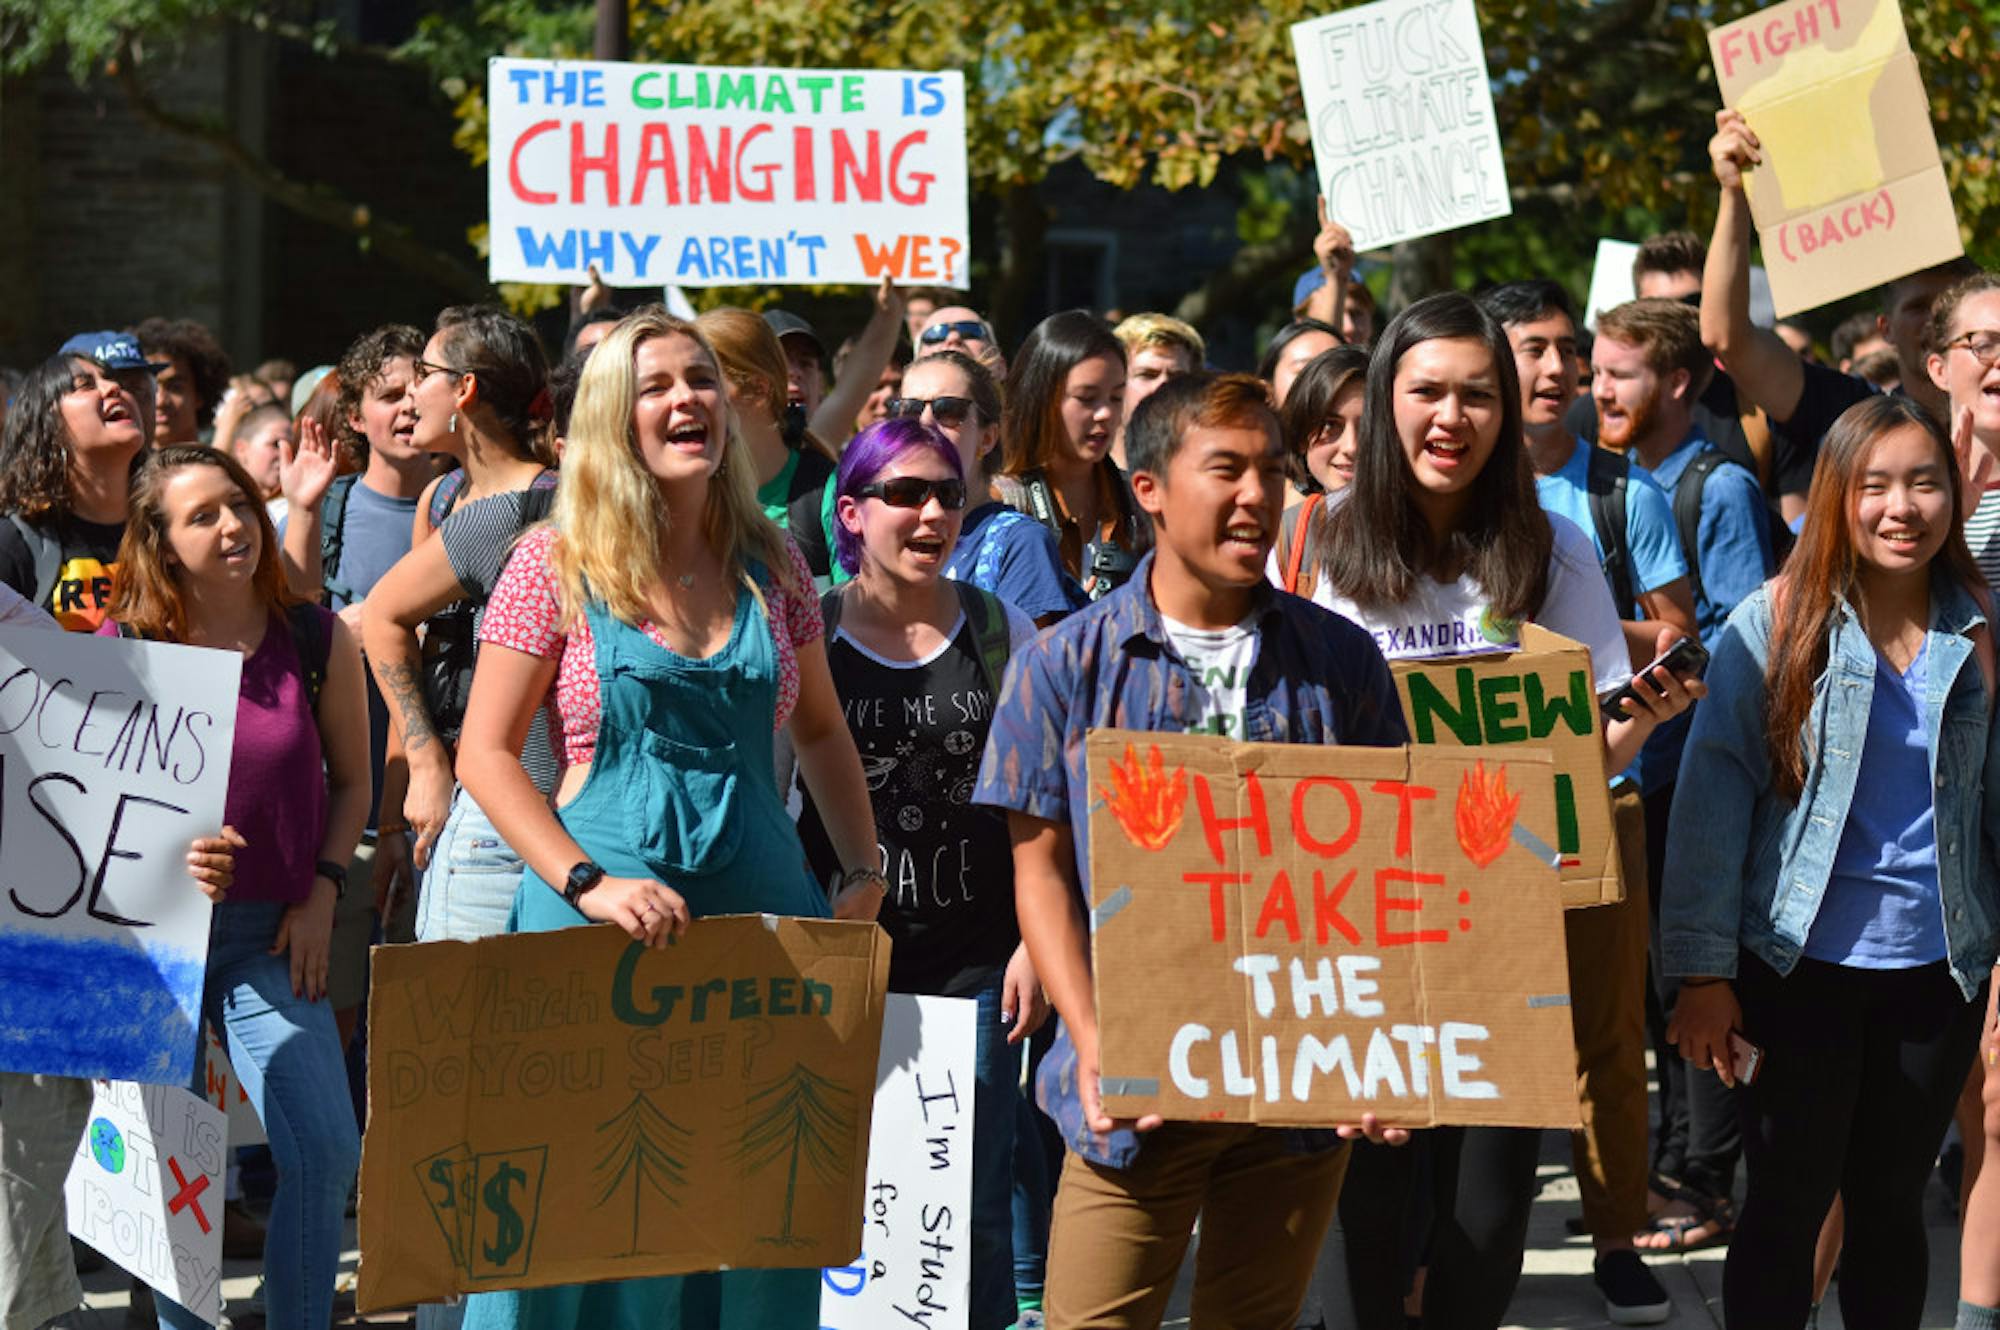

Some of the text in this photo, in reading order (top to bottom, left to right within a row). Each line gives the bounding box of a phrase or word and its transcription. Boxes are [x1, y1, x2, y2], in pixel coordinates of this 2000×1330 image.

[1319, 1, 1471, 91] FUCK
[1718, 0, 1841, 80] FIGHT
[508, 68, 946, 117] THE CLIMATE IS
[1317, 66, 1485, 158] CLIMATE
[508, 120, 936, 207] CHANGING
[1329, 135, 1500, 244] CHANGE
[515, 227, 962, 281] WHY AREN'T WE?
[1778, 190, 1898, 262] (BACK)
[1373, 620, 1485, 652] EXANDRI
[0, 668, 212, 784] OCEANS
[903, 695, 936, 726] ME
[1406, 667, 1593, 746] NEW
[1193, 769, 1437, 866] HOT
[1182, 868, 1472, 948] TAKE:
[404, 964, 600, 1044] Which
[1232, 954, 1385, 1019] THE
[1168, 1021, 1501, 1103] CLIMATE
[915, 1069, 960, 1171] I'm
[870, 1179, 898, 1281] for a
